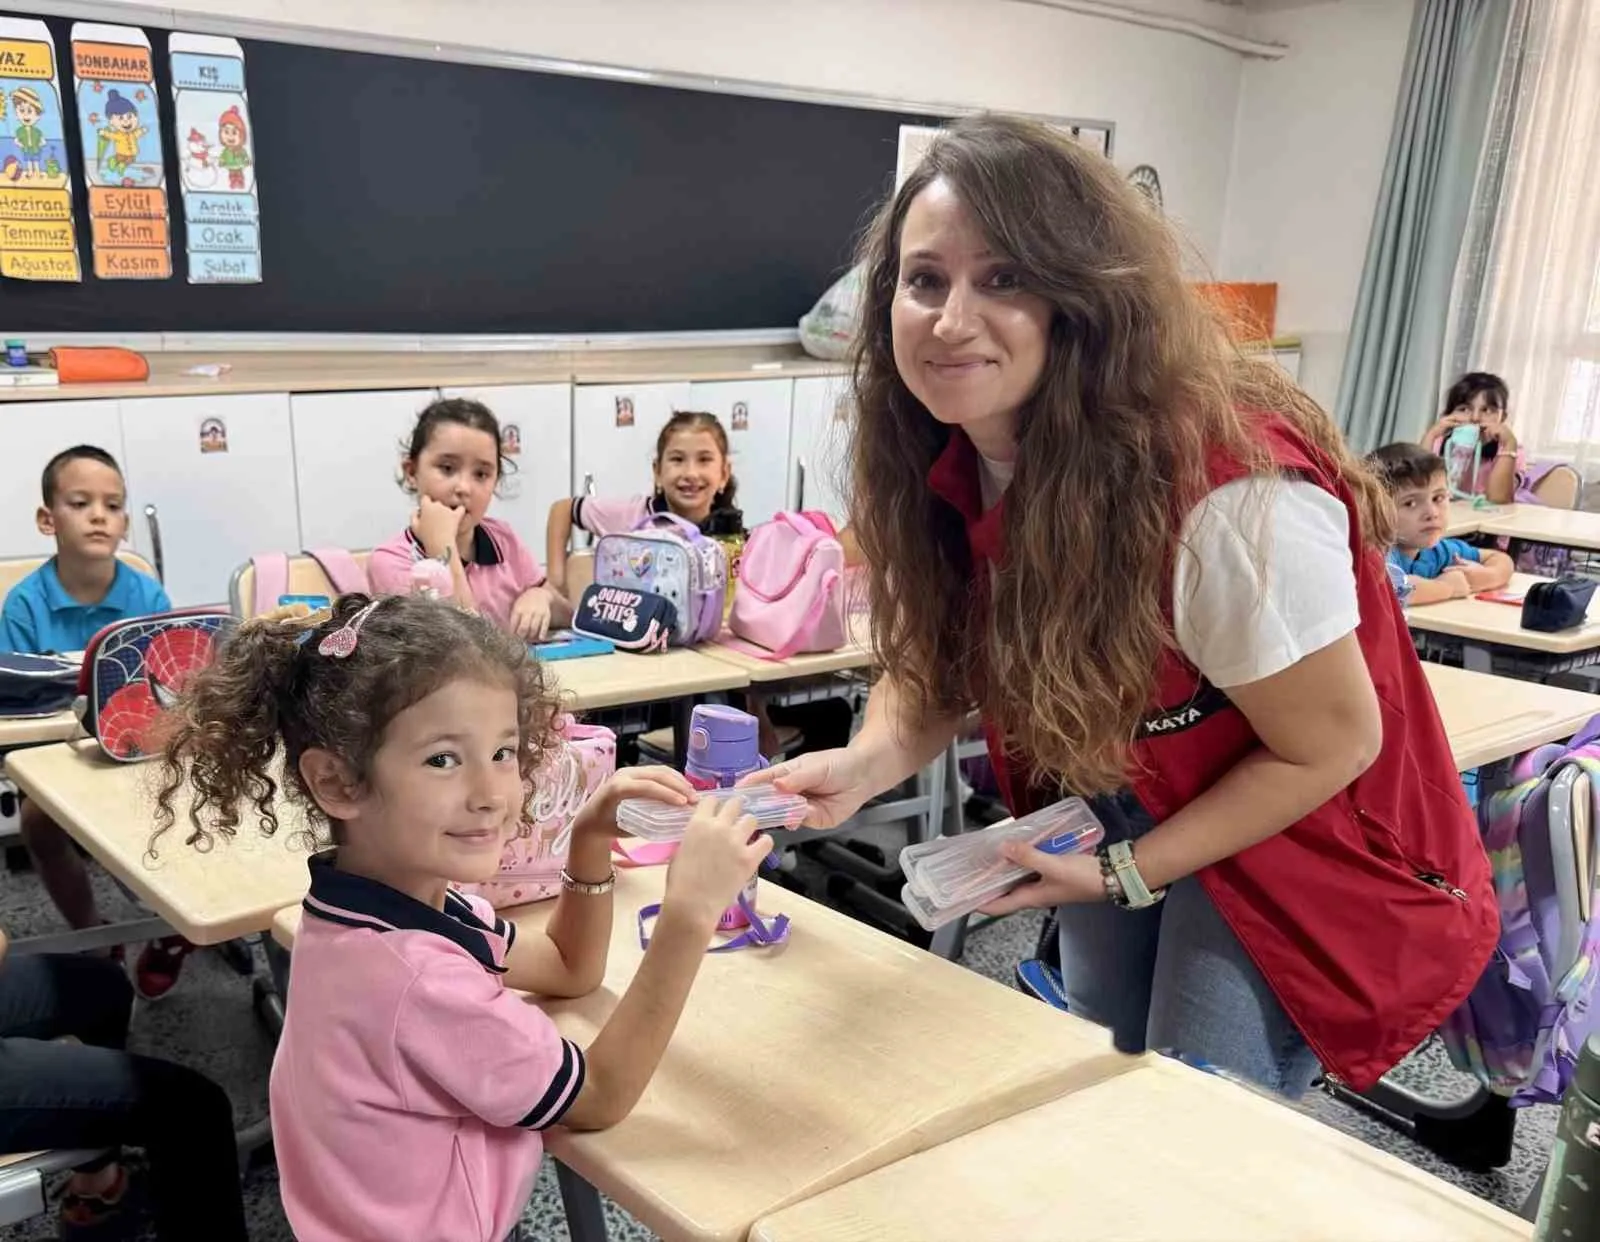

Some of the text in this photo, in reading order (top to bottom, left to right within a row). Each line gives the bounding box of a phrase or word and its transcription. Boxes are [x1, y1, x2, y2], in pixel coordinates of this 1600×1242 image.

[76, 53, 149, 73] SONBAHAR
[104, 192, 151, 213] Eylül
[1, 224, 69, 240] Temmuz
[109, 222, 154, 239] Ekim
[202, 227, 244, 243] Ocak
[10, 256, 73, 273] Ağustos
[106, 253, 160, 270] Kasım
[203, 258, 247, 275] Şubat
[592, 602, 637, 623] GIRLS
[1146, 708, 1201, 732] KAYA
